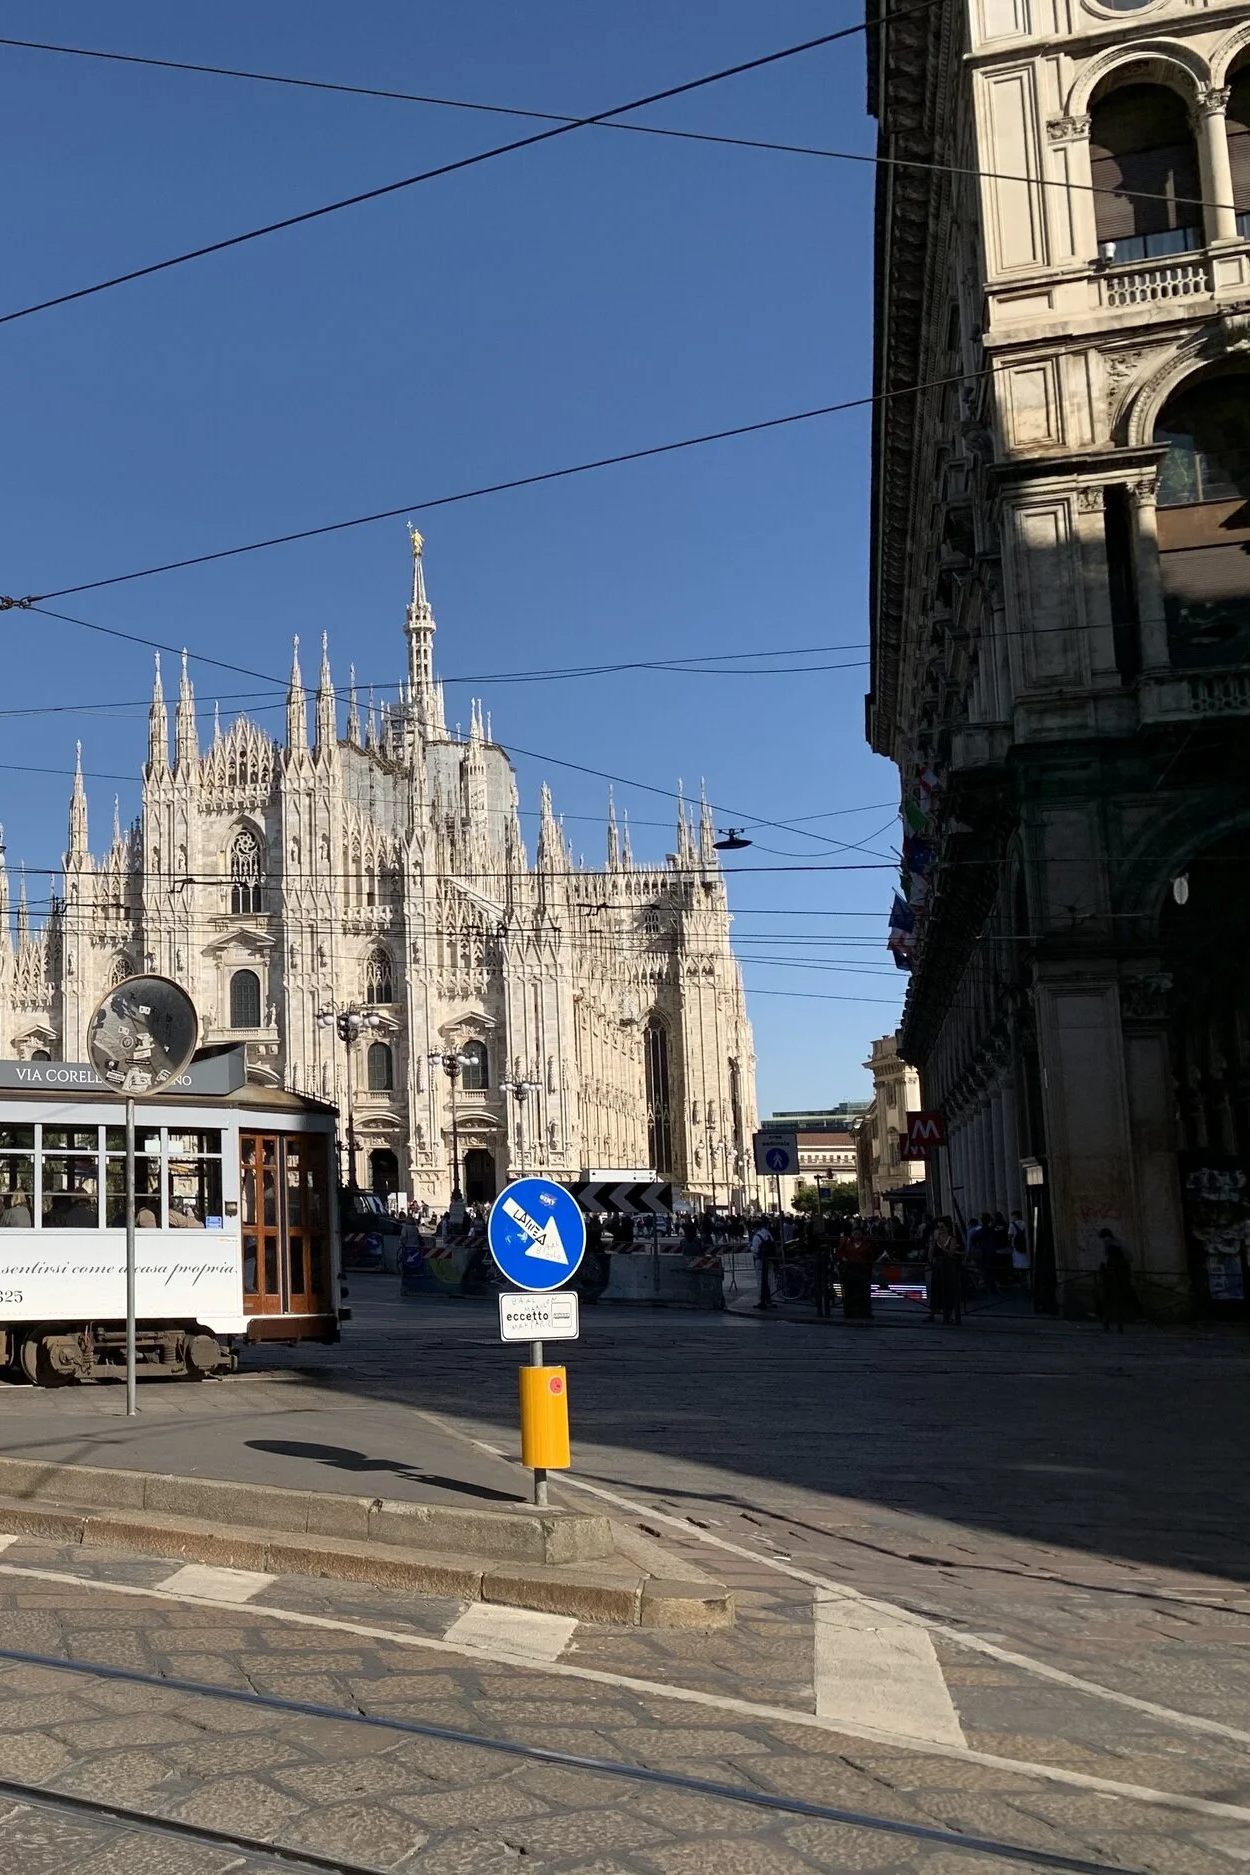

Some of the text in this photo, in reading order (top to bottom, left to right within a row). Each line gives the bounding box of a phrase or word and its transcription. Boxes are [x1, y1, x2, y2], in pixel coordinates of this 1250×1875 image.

[15, 1068, 43, 1082] VIA
[45, 1069, 103, 1084] CORELL
[911, 1119, 941, 1140] M
[1, 1261, 70, 1276] sentirsi
[71, 1264, 115, 1276] come
[133, 1265, 168, 1276] casa
[506, 1311, 549, 1321] eccetto
